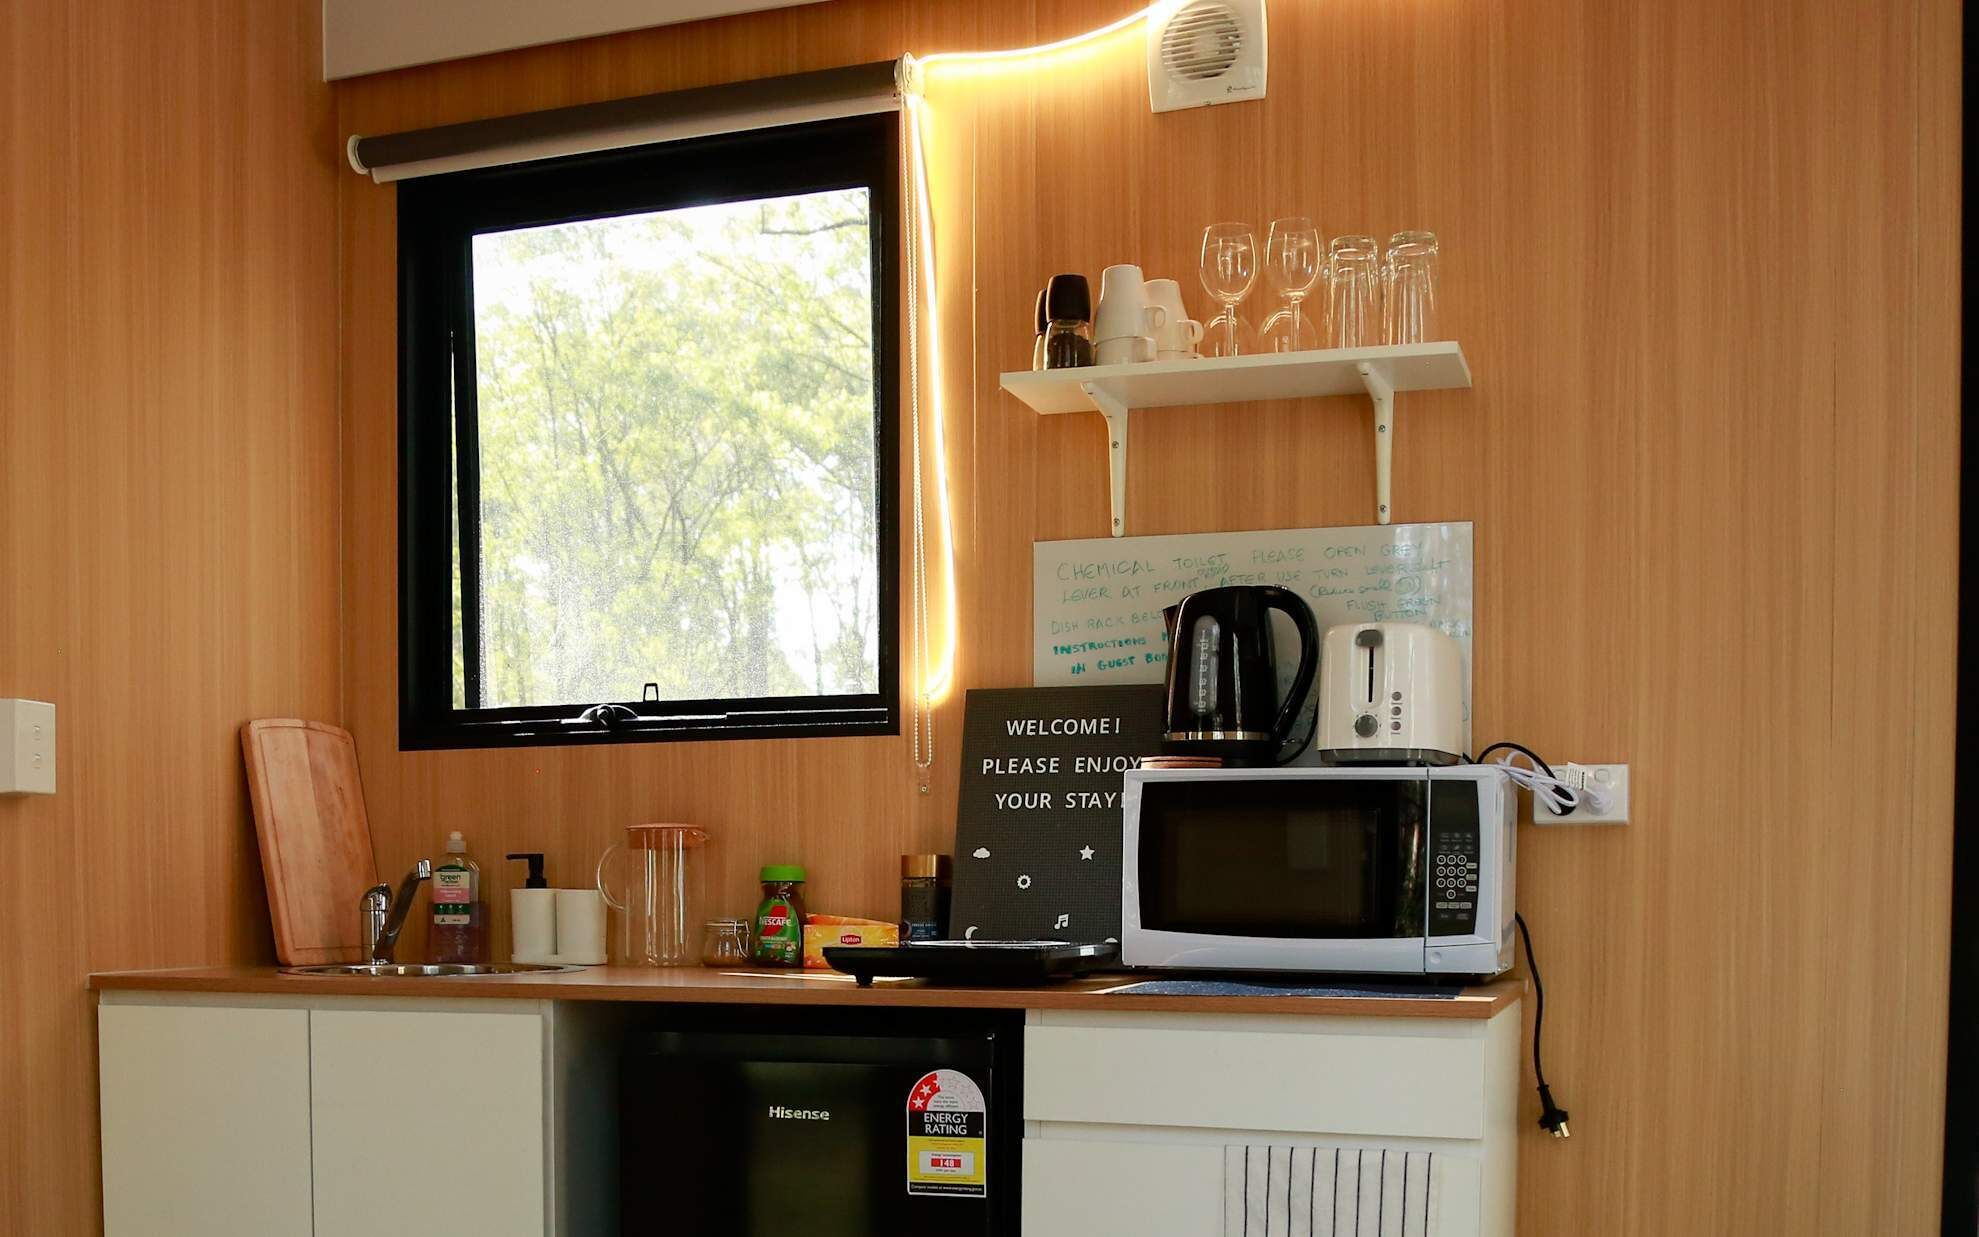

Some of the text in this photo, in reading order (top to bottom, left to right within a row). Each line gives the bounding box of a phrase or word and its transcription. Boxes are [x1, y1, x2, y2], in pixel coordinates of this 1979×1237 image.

[1057, 560, 1155, 580] CHEMICAL
[1172, 553, 1227, 569] TOILET
[1251, 547, 1304, 564] PLEASE
[1324, 546, 1365, 560] OPEN
[1062, 586, 1112, 604] LEVER
[1121, 585, 1141, 599] AT
[1220, 572, 1265, 588] AFTER
[1051, 620, 1080, 635] DISH
[1053, 637, 1146, 655] INSTRUCTIONS
[1071, 662, 1086, 675] IN
[1097, 655, 1136, 671] GUEST
[1006, 718, 1120, 736] WELCOME!
[982, 756, 1142, 775] PLEASE ENJOY
[995, 792, 1052, 809] YOUR
[842, 936, 860, 944] Lipton
[768, 1105, 830, 1120] Hisense
[924, 1113, 968, 1124] ENERGY
[925, 1124, 967, 1135] RATING
